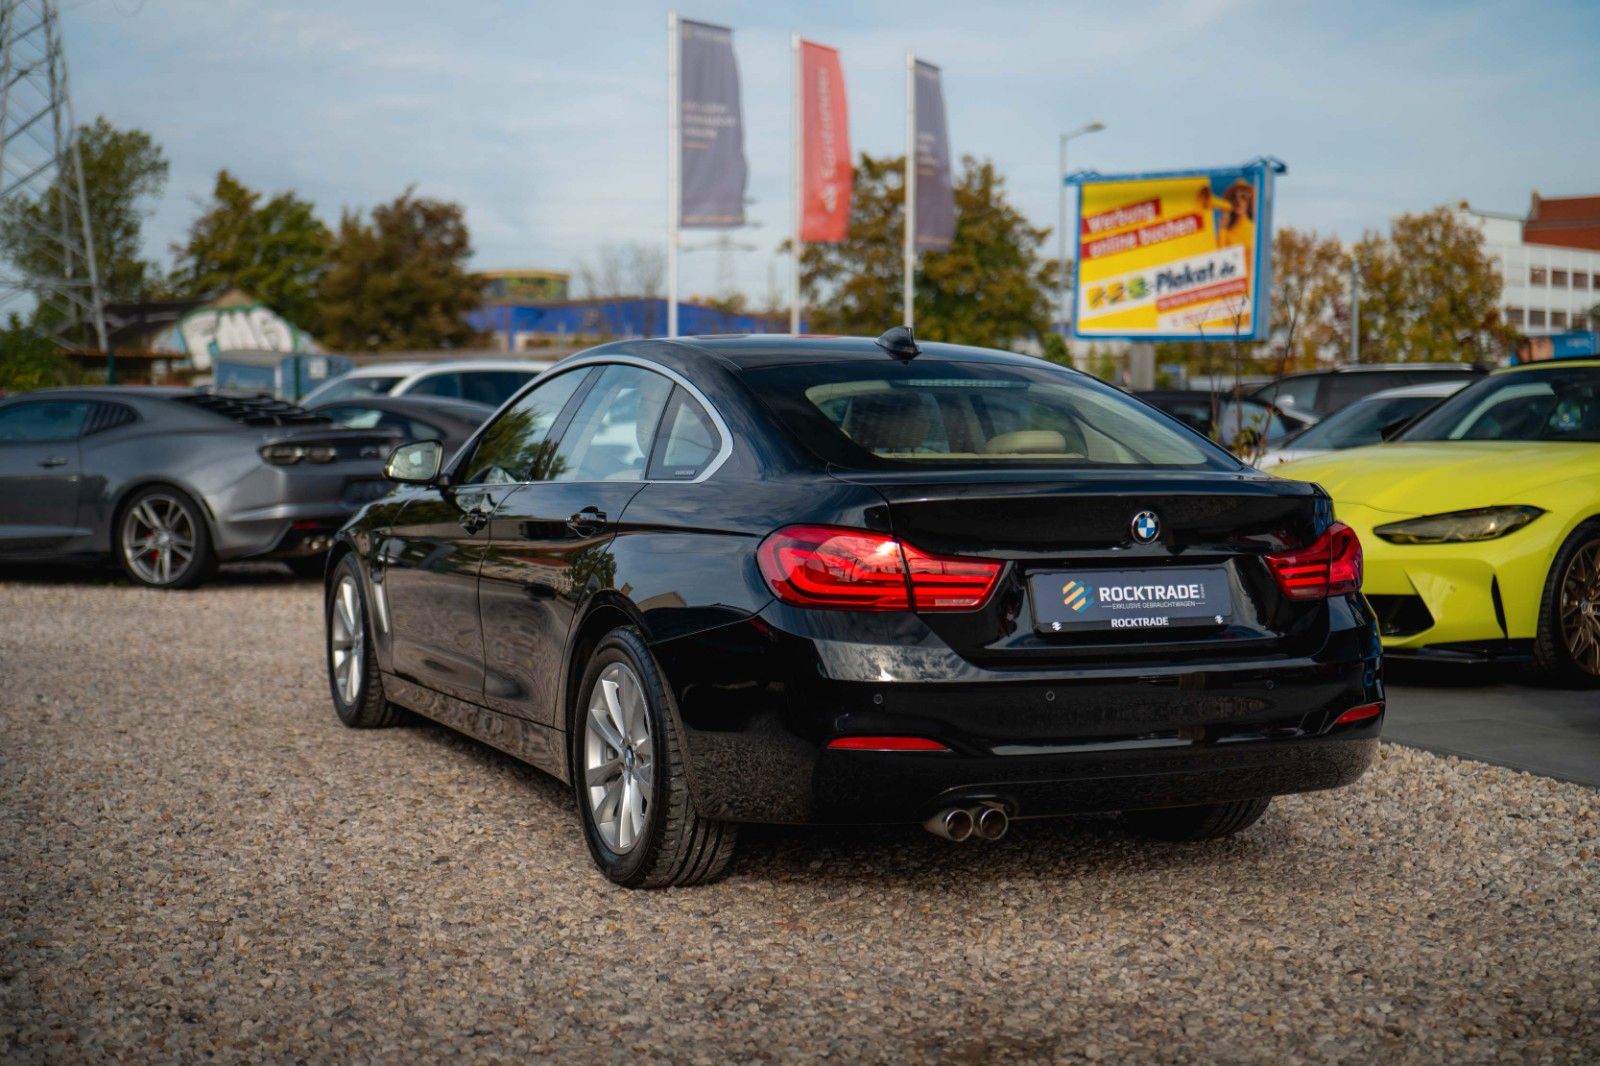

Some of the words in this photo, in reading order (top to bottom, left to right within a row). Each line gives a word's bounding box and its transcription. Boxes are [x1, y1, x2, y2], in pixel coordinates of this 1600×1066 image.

[1099, 584, 1200, 602] ROCKTRADE
[1112, 602, 1141, 610] EXKLUSIVE
[1142, 600, 1196, 609] GEBRAUCHTWAGEN
[1111, 616, 1169, 628] ROCKTRADE
